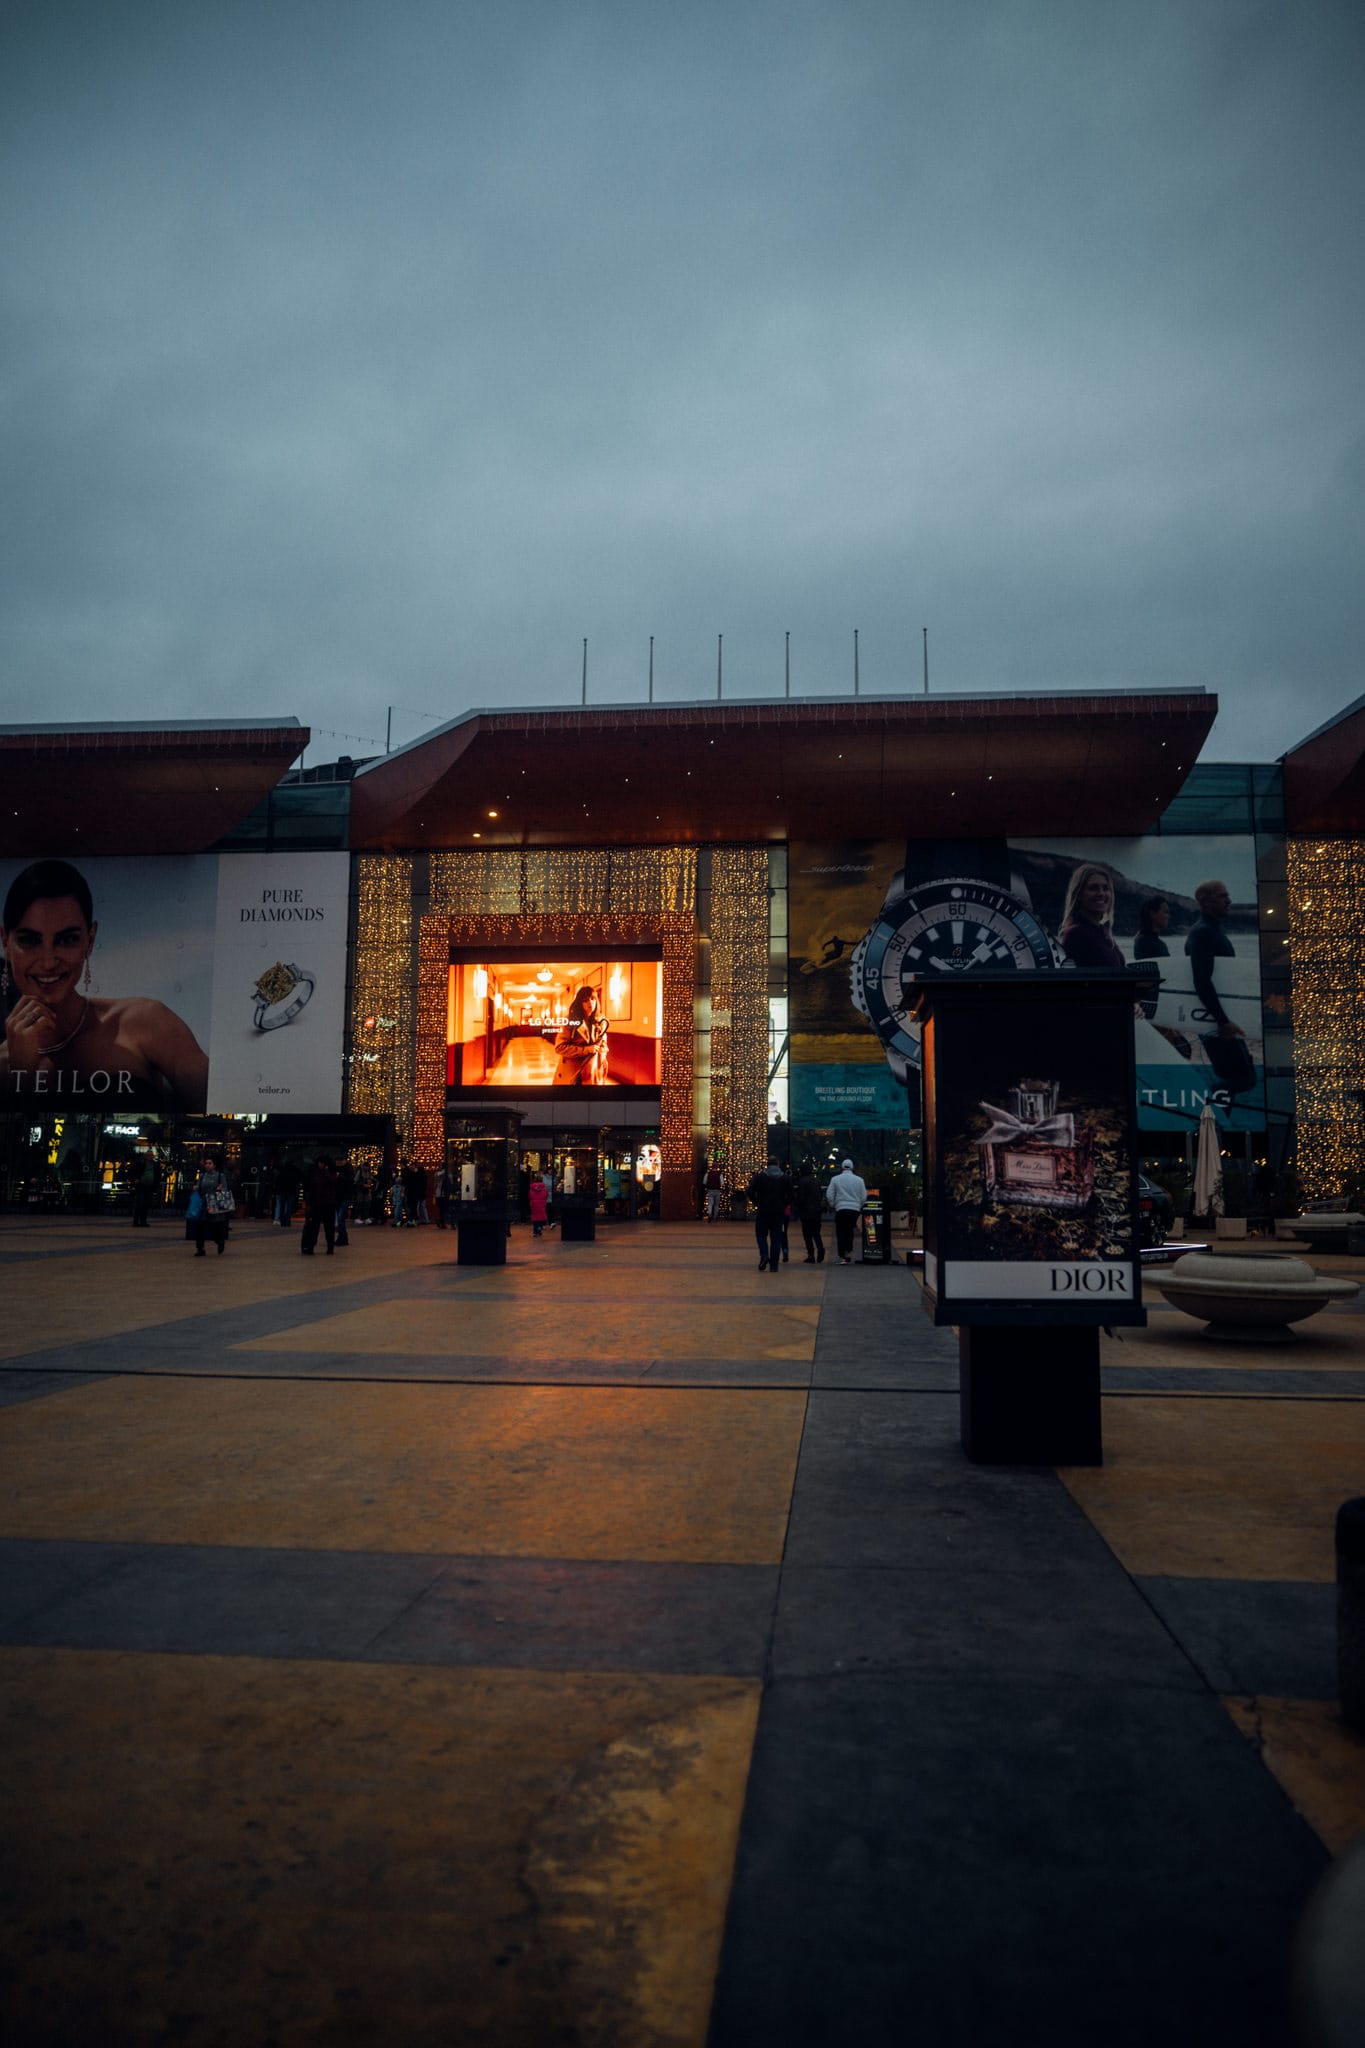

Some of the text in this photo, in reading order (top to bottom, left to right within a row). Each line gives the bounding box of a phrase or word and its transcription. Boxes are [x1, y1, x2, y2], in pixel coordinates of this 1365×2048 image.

[263, 889, 304, 904] PURE
[240, 907, 325, 922] DIAMONDS
[949, 904, 967, 915] 60
[889, 934, 907, 952] 50
[1012, 935, 1026, 951] 10
[865, 968, 880, 991] 45
[529, 1018, 542, 1026] LG
[544, 1018, 569, 1026] OLED
[10, 1070, 136, 1094] TEILOR
[1049, 1269, 1127, 1292] DIOR
